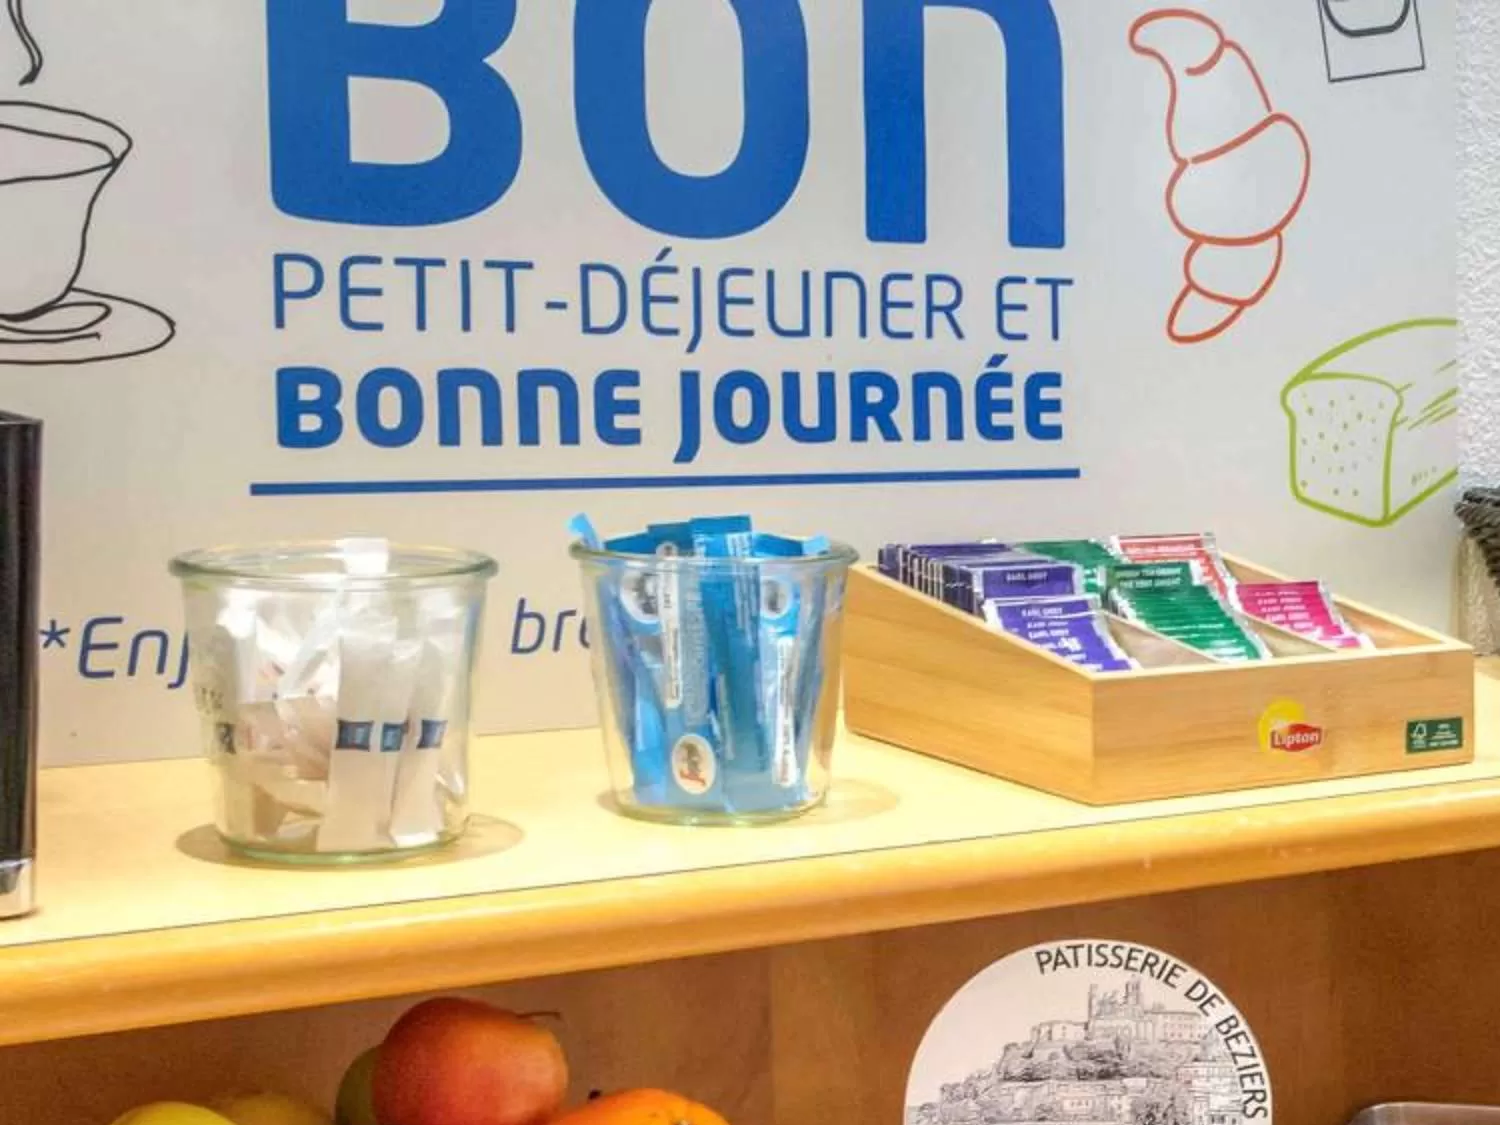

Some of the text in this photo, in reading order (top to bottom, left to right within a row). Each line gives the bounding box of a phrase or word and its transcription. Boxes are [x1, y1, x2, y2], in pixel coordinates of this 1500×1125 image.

[273, 248, 1073, 352] PETIT-DÉJEUNER ET
[275, 354, 1063, 463] BONNE JOURNÉE
[1274, 731, 1319, 747] Lipton
[1035, 943, 1268, 1119] PATISSERIE DE BEZIERS
